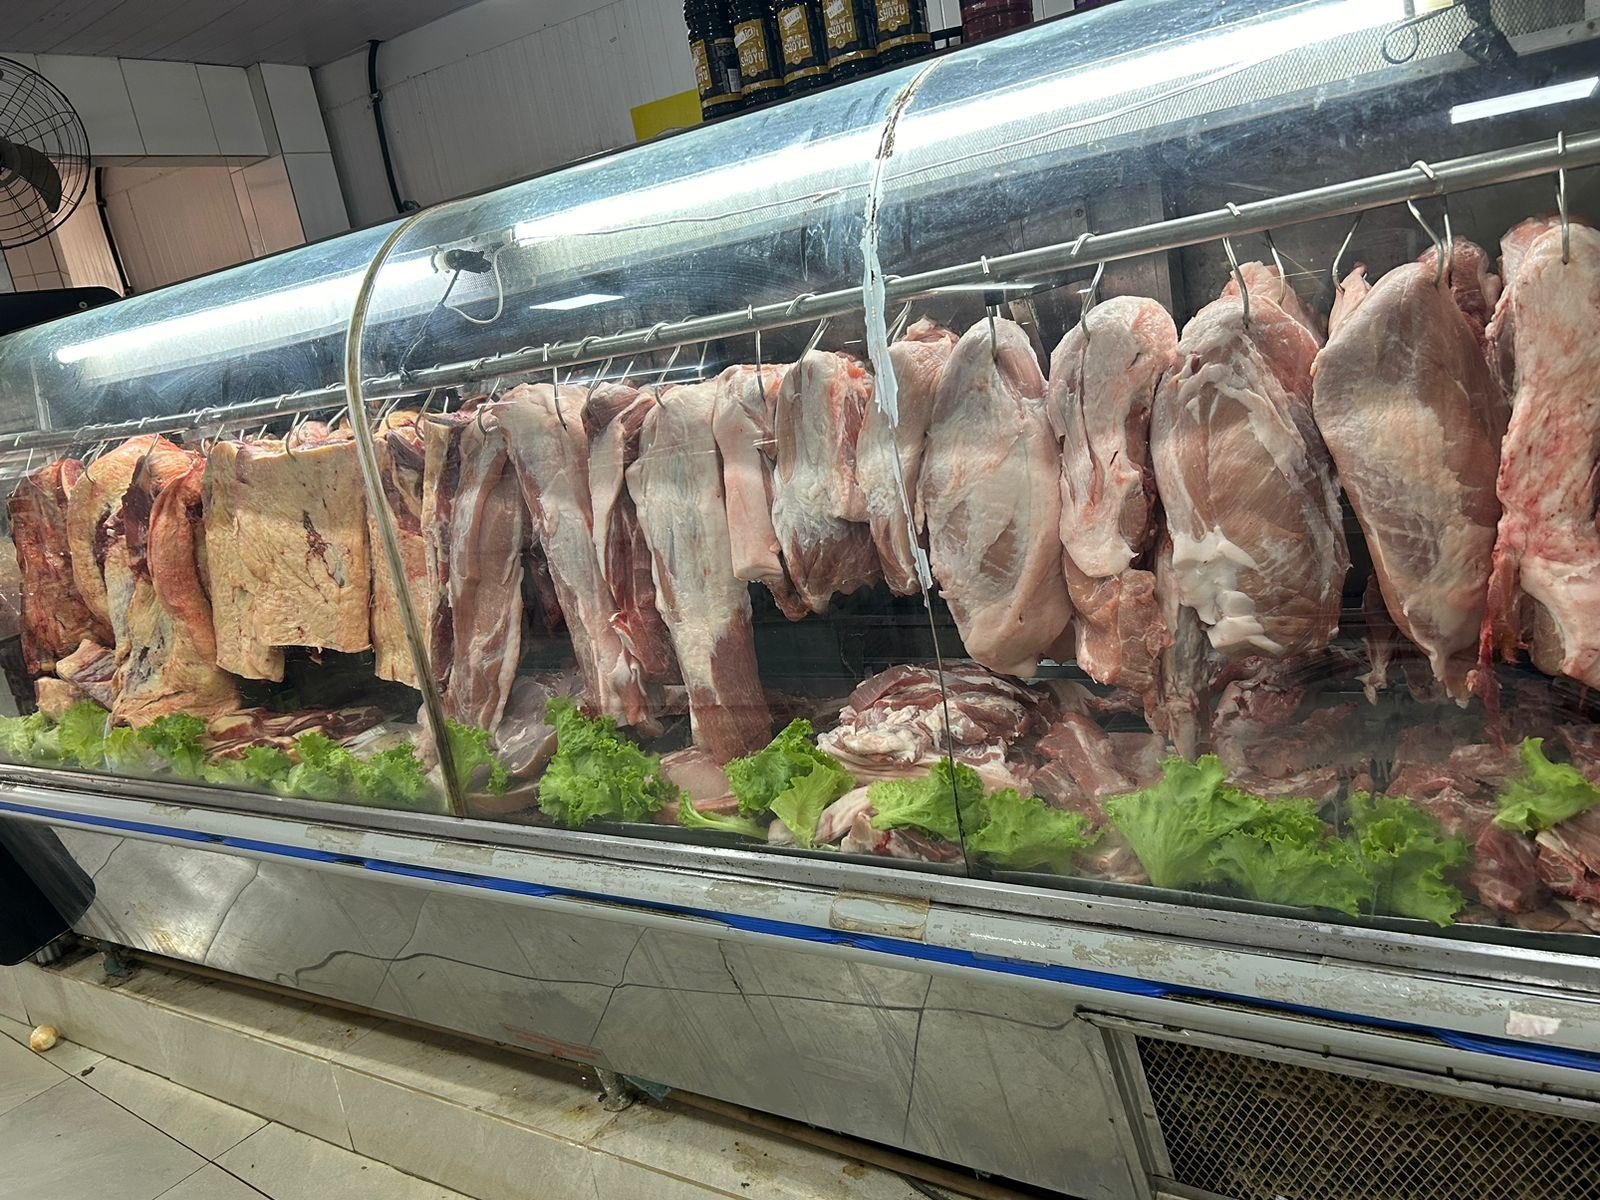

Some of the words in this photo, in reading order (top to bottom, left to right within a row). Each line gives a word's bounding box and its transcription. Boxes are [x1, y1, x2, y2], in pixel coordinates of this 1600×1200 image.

[878, 4, 905, 21] SHOYU
[828, 21, 852, 38] SHOYU
[740, 51, 764, 67] SHOYU
